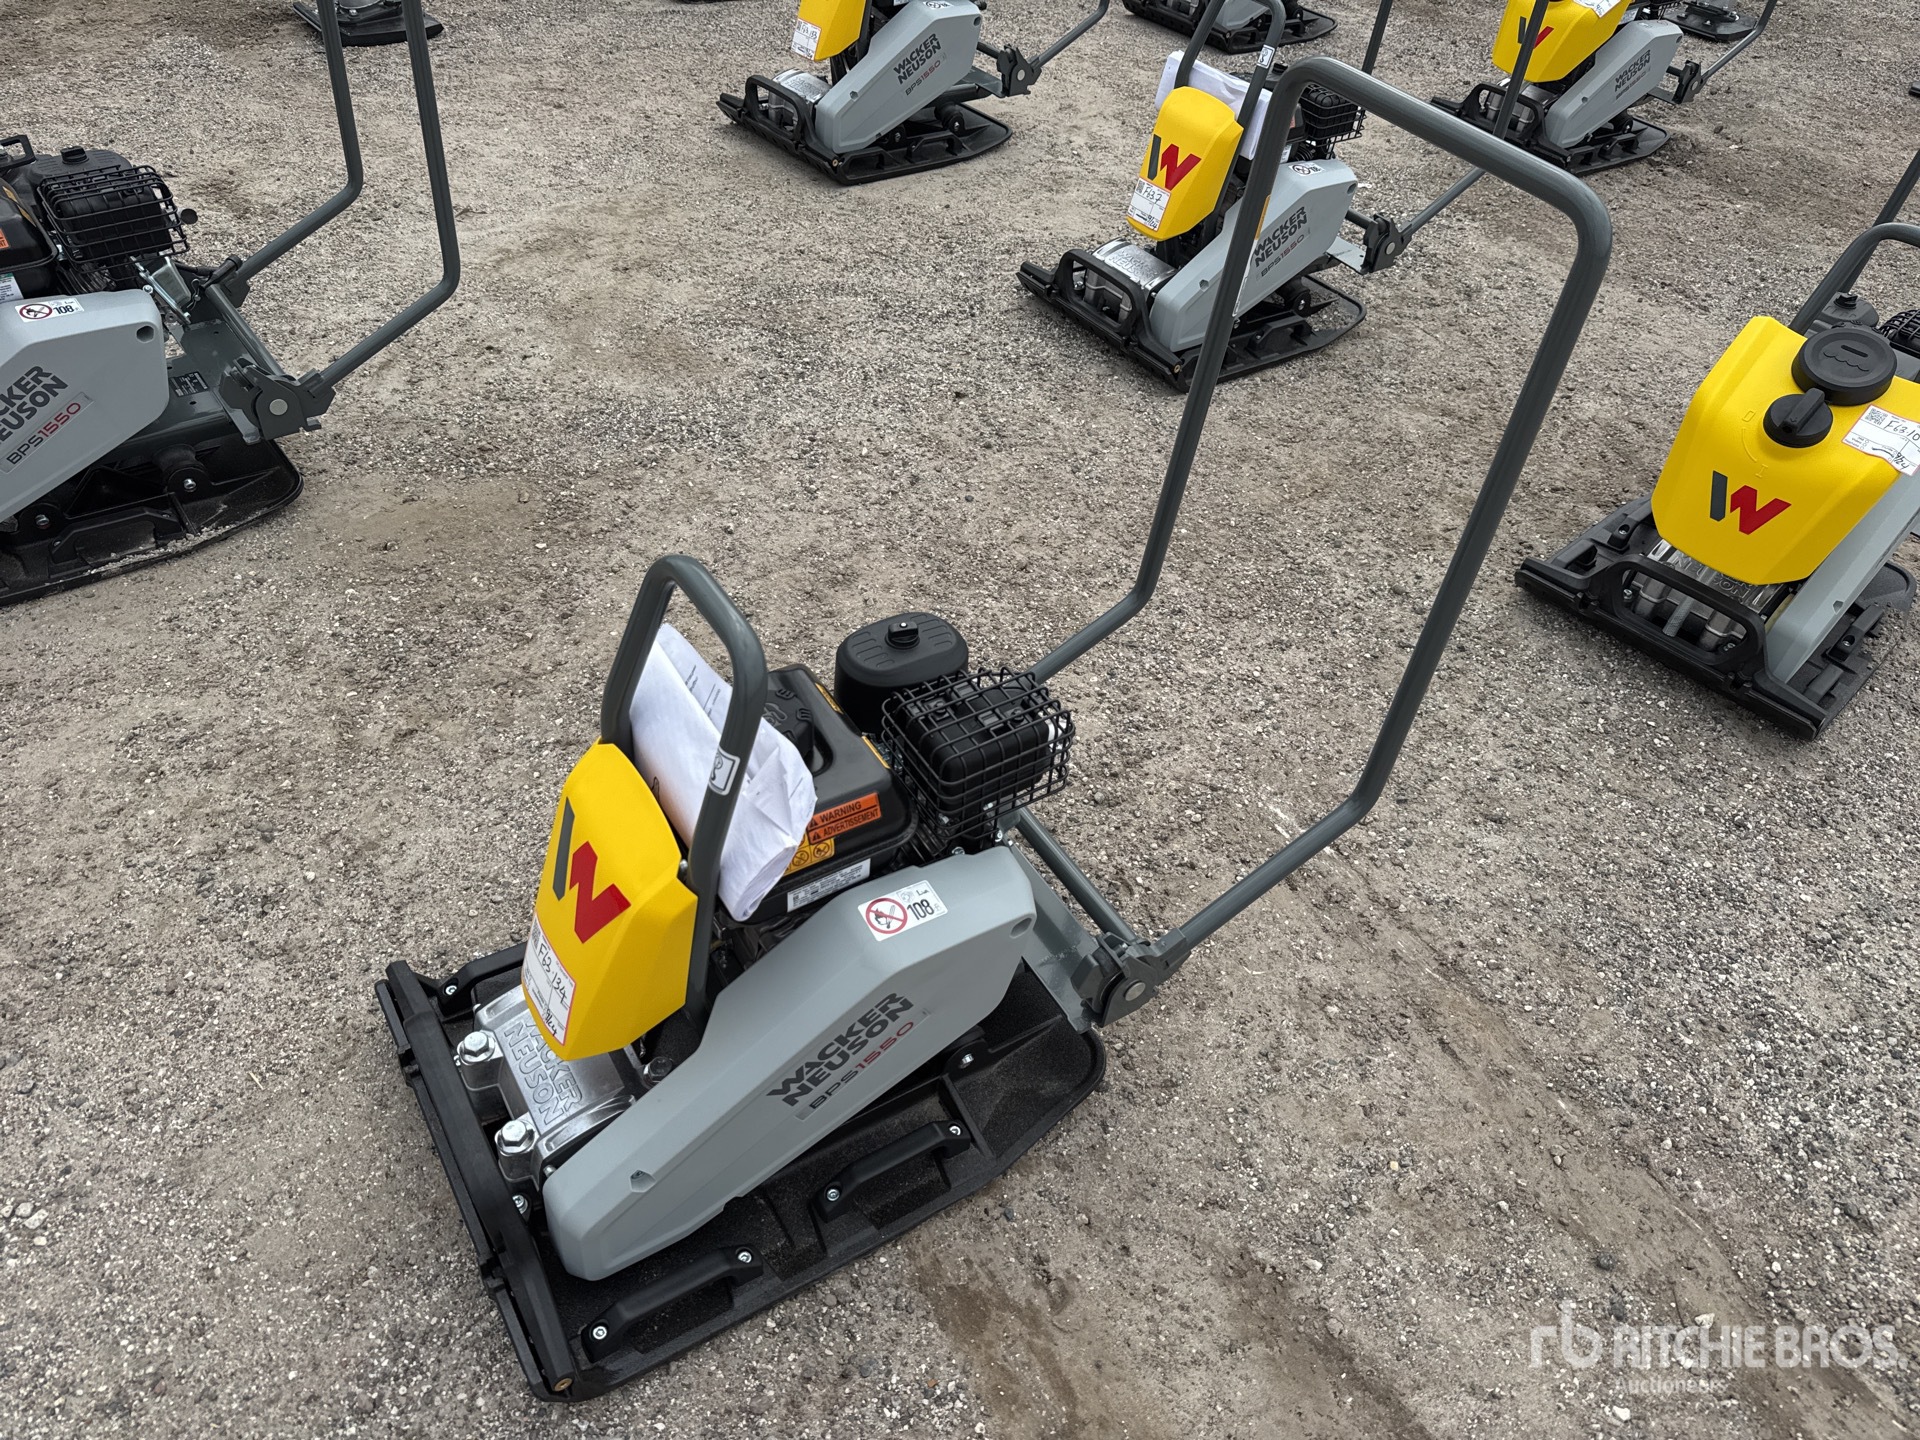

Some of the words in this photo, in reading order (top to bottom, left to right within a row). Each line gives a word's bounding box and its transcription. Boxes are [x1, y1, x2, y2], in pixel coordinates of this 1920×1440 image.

[893, 33, 938, 75] WACKER
[897, 41, 941, 84] NEUSON
[1614, 55, 1651, 92] NEUSON
[1615, 49, 1651, 83] WACKER
[905, 60, 941, 96] BPS1550
[1254, 206, 1306, 256] WACKER
[1254, 214, 1308, 267] NEUSON
[1260, 234, 1304, 277] BPS1550
[6, 403, 81, 465] BPS1550
[820, 801, 862, 823] WARNING
[823, 808, 879, 836] ADVERTISSEMENT
[907, 899, 934, 921] 108
[766, 993, 905, 1096] WACKER
[782, 998, 914, 1107] NEUSON
[809, 1021, 914, 1109] BPS1550
[504, 1021, 564, 1125] NEUSON
